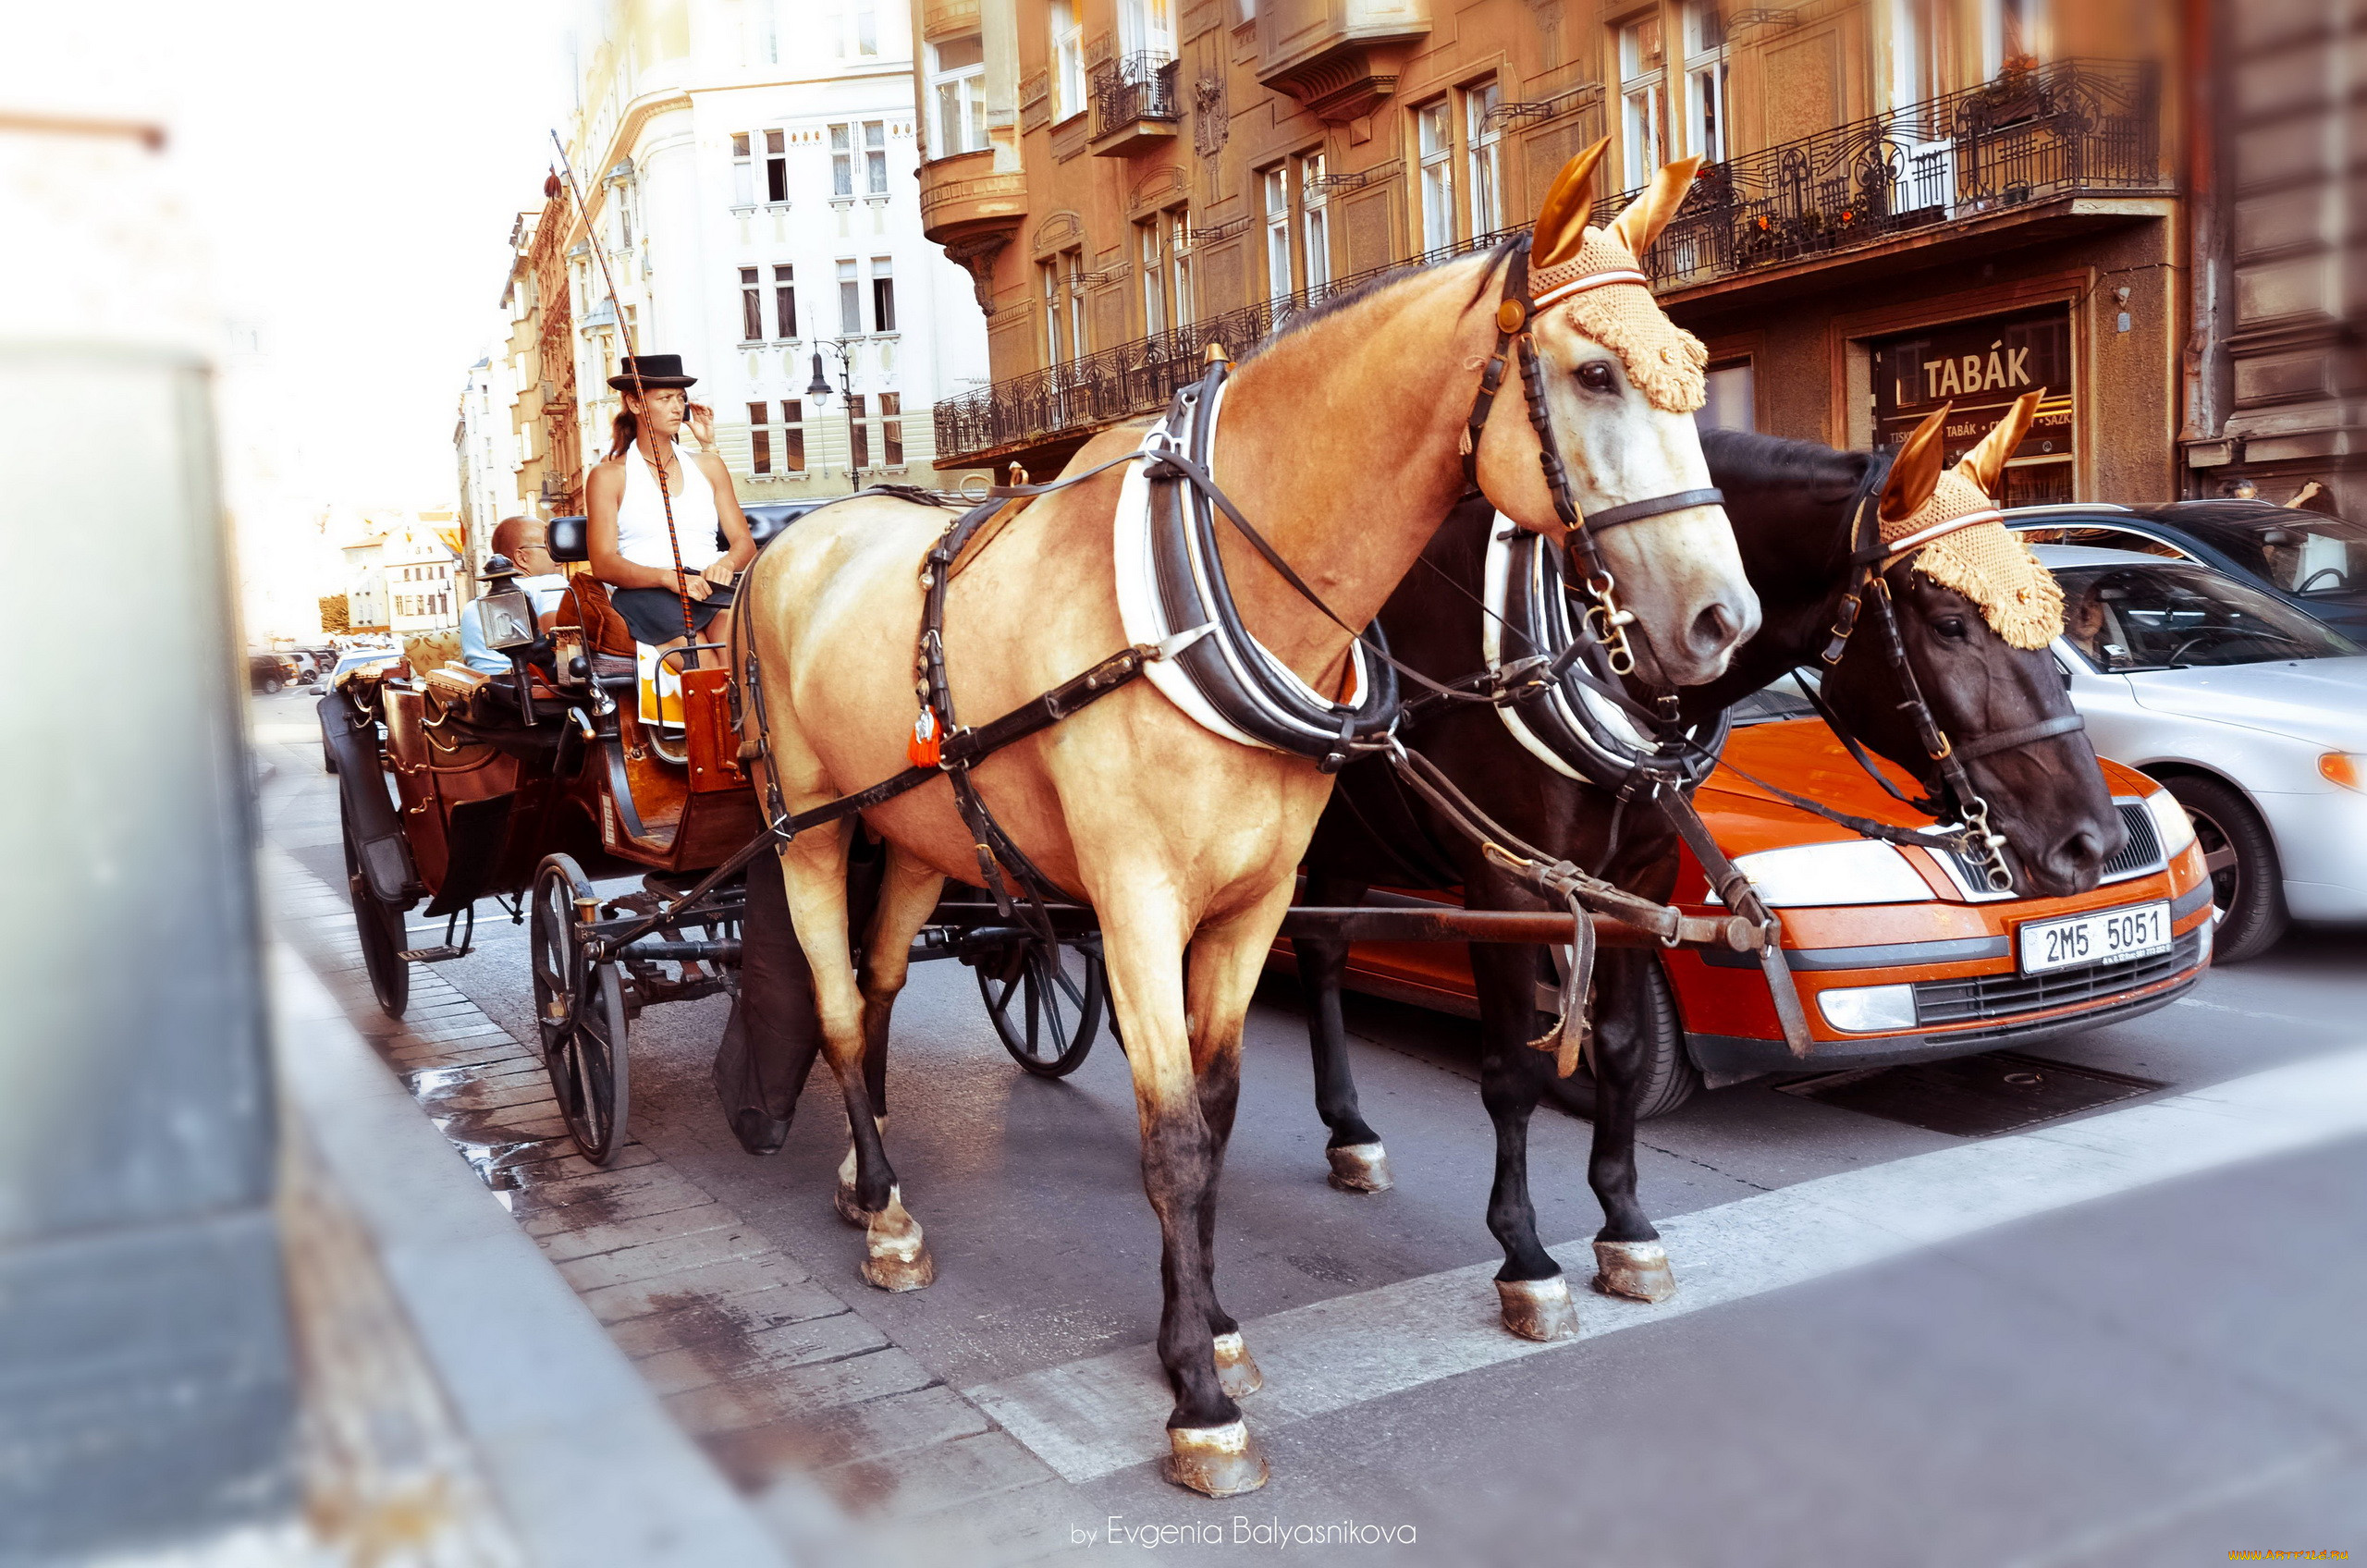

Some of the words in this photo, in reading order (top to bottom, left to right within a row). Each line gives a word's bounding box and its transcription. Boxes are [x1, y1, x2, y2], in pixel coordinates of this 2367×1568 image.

[1923, 339, 2030, 398] TABÁK
[1946, 422, 1976, 437] TABÁK
[2045, 413, 2072, 426] SAZK
[2045, 924, 2089, 962] 2M5
[2108, 910, 2159, 949] 5051
